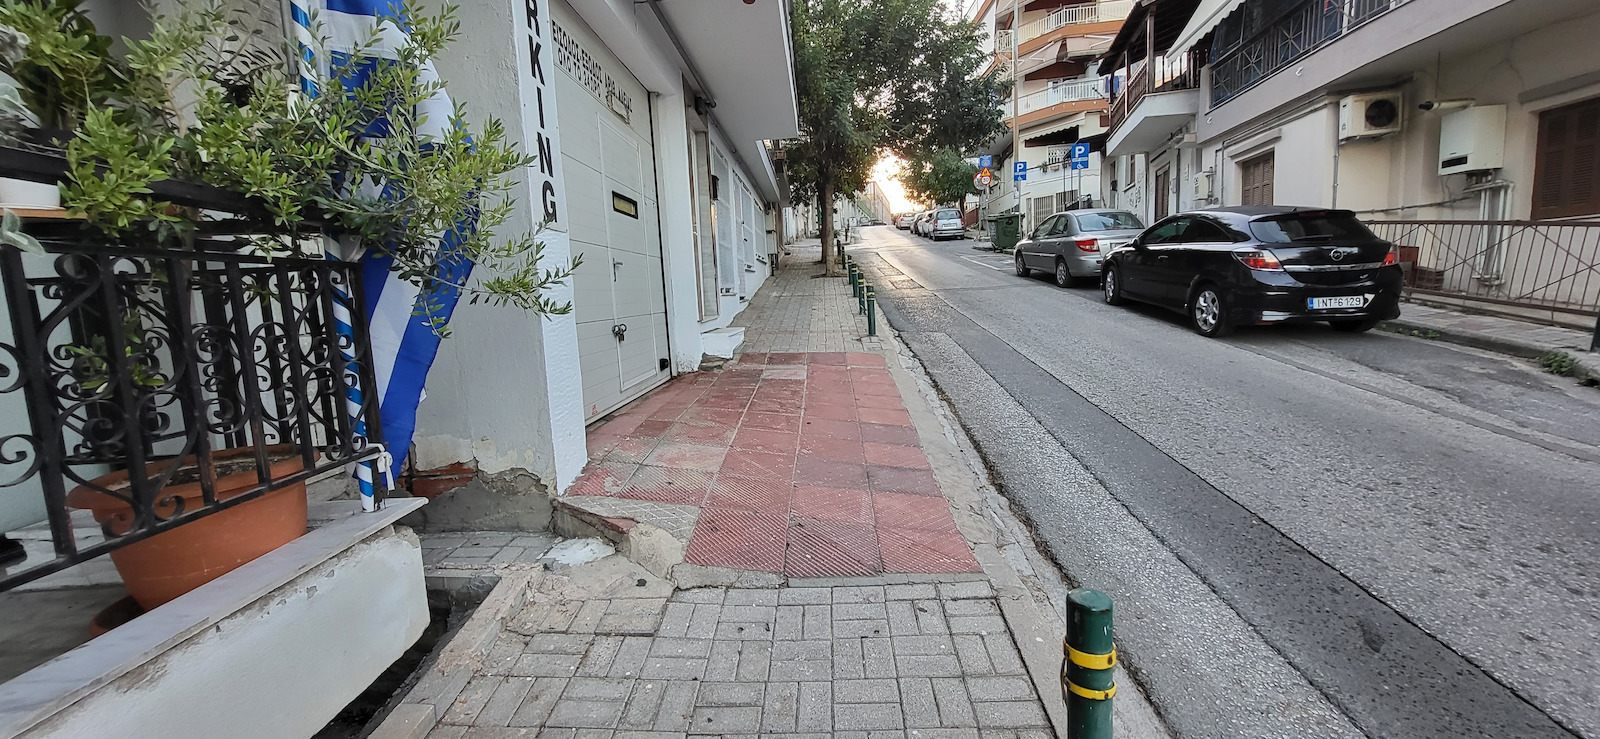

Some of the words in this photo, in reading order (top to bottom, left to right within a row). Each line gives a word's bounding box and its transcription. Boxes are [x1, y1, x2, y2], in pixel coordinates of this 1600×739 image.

[573, 61, 582, 82] ΤΟ
[1075, 145, 1085, 158] P
[1016, 163, 1024, 173] P
